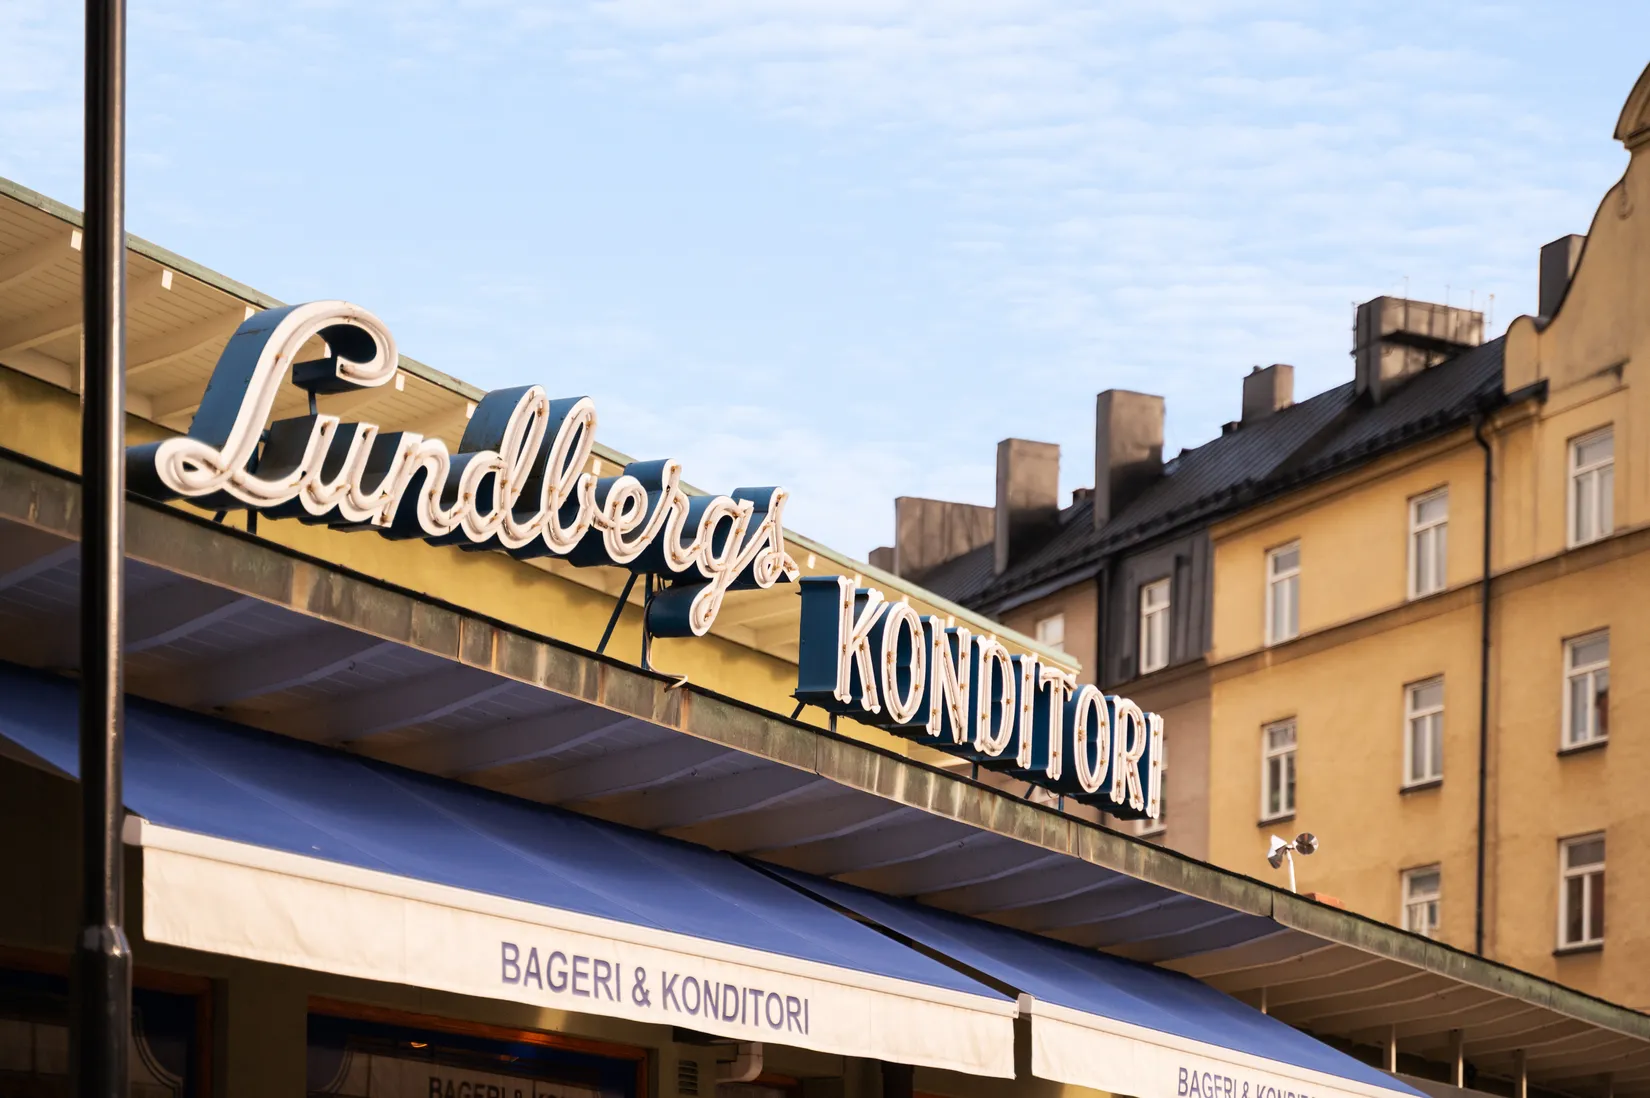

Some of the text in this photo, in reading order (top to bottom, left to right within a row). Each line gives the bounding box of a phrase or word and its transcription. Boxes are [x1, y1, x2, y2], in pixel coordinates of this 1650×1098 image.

[154, 299, 800, 637] Lundbergs
[833, 575, 1164, 820] KONDITORI
[500, 940, 809, 1036] BAGERI & KONDITORI
[1177, 1066, 1237, 1098] BAGERI
